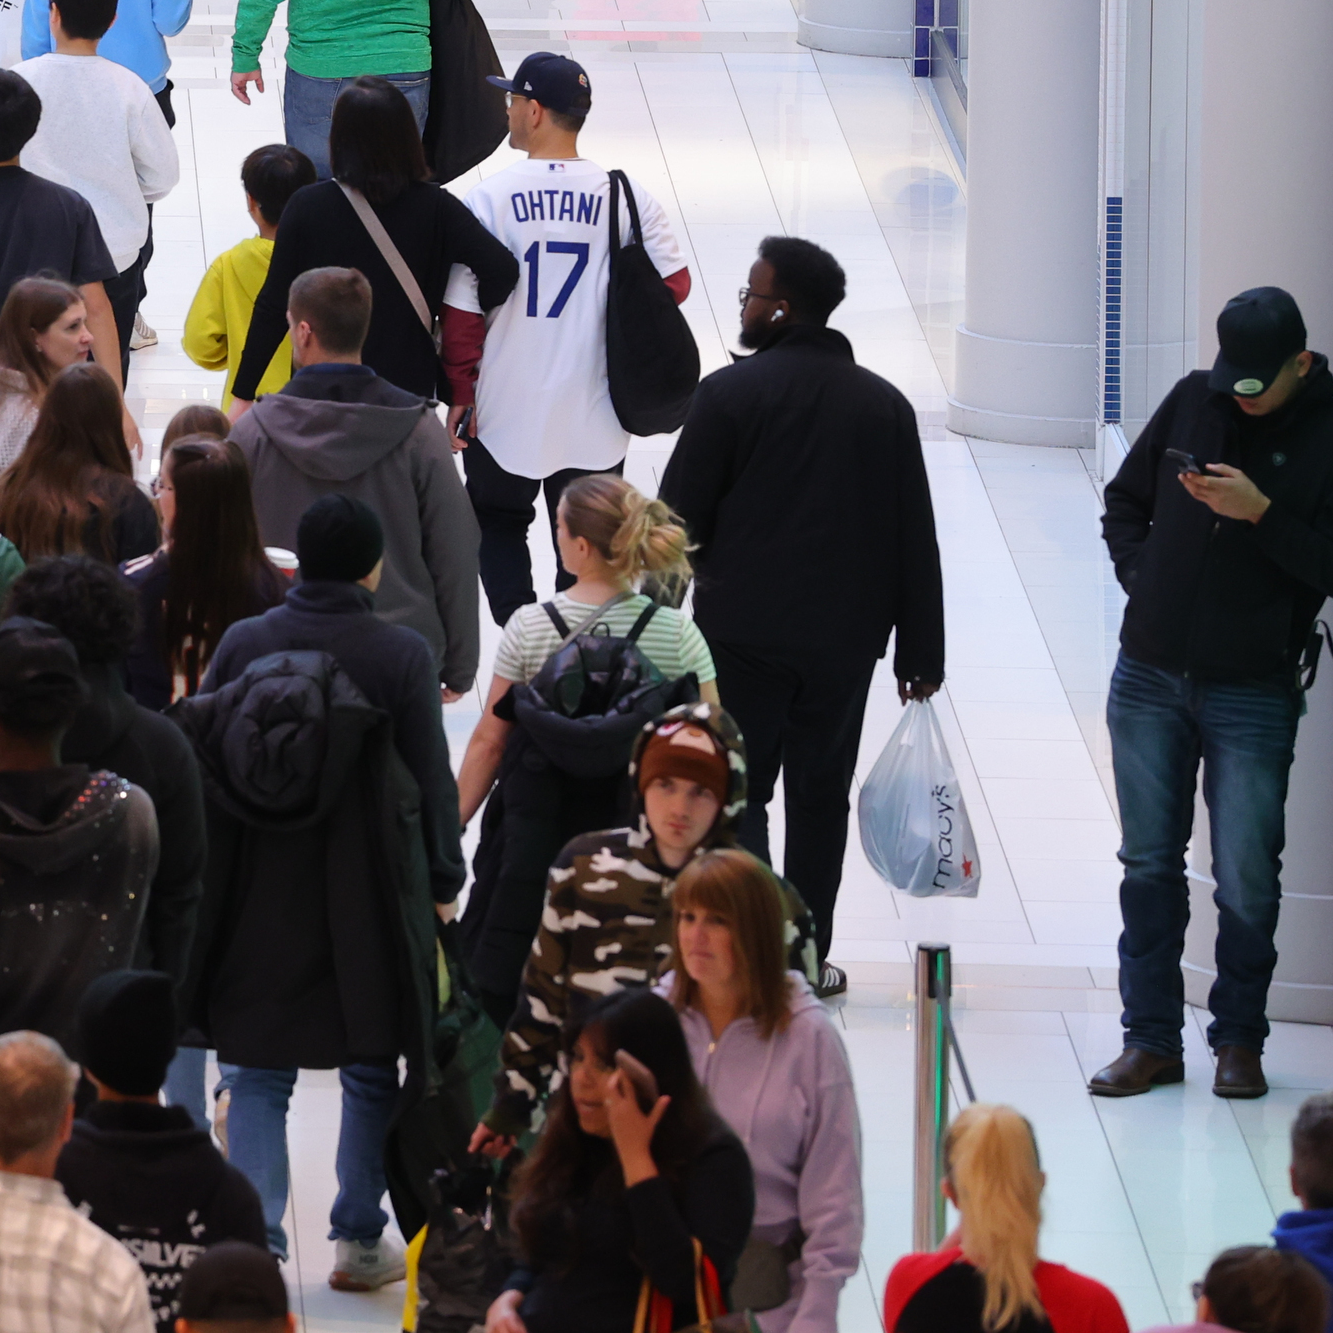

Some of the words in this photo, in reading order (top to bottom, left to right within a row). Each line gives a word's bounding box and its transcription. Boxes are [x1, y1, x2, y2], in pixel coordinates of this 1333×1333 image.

[510, 189, 603, 227] OHTANI
[523, 240, 591, 319] 17
[932, 784, 955, 889] macy's
